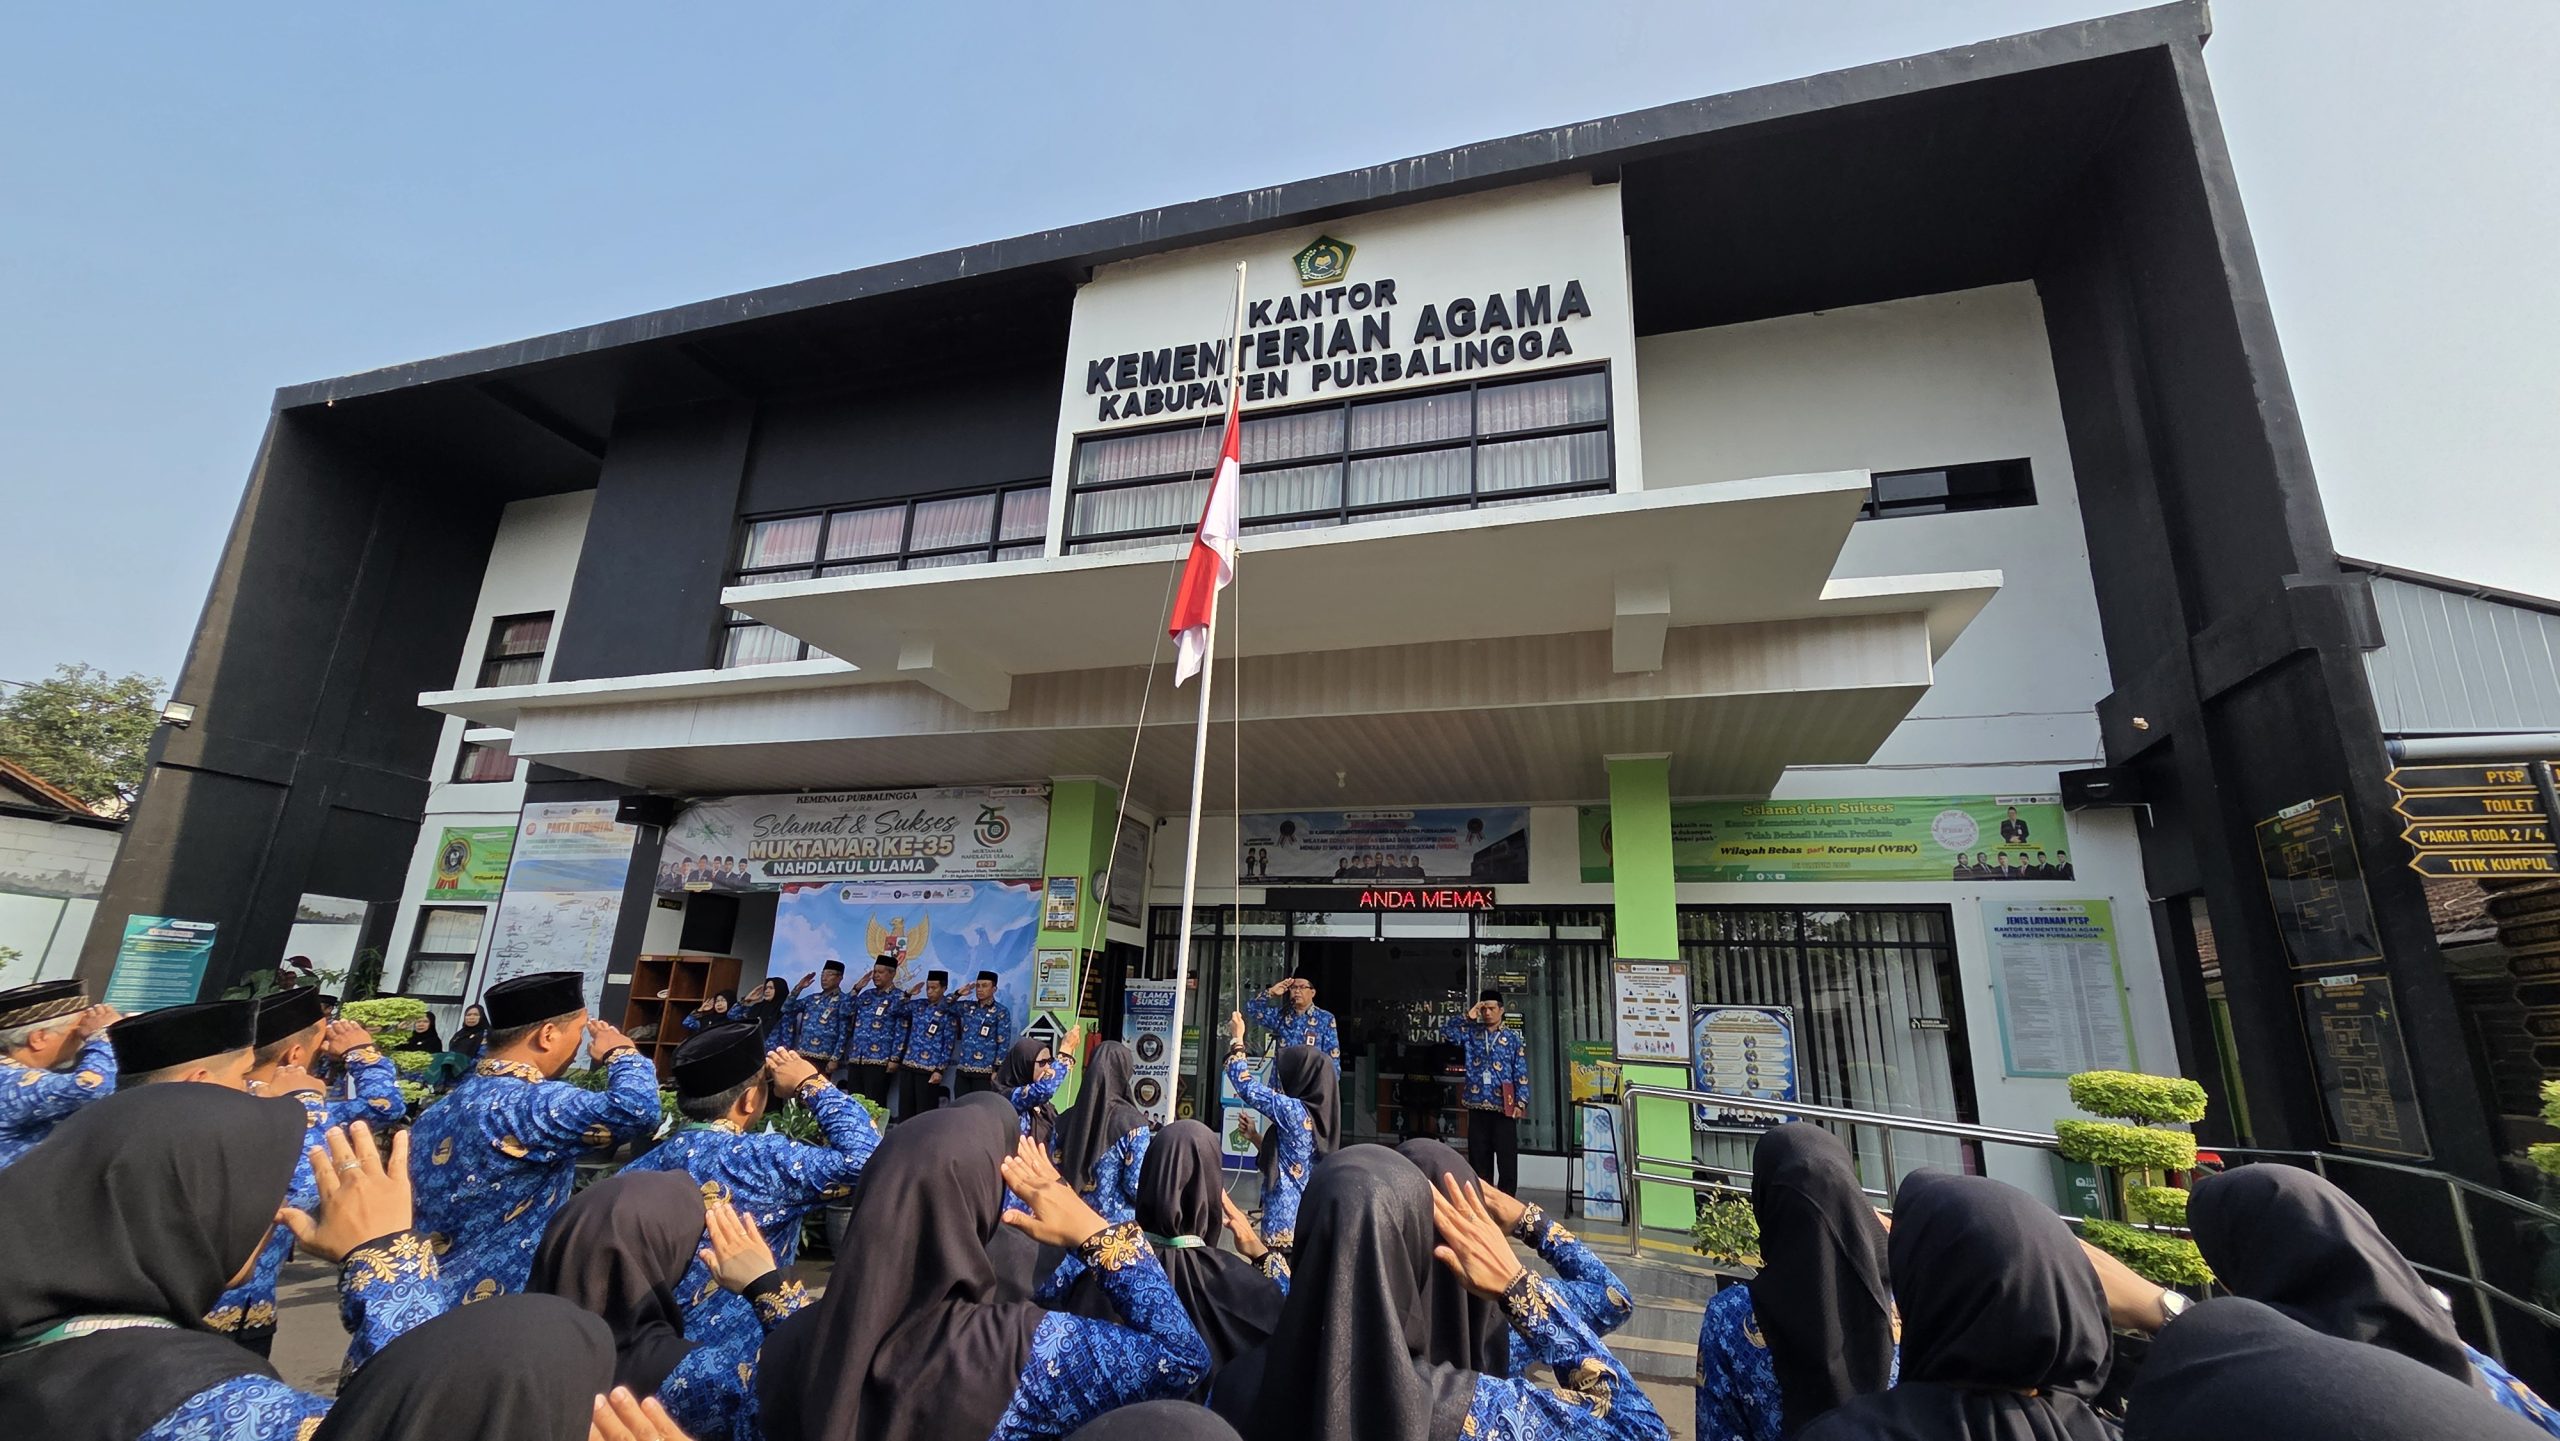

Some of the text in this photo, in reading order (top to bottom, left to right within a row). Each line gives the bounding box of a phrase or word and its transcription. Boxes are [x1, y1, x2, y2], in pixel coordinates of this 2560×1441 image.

[1249, 279, 1397, 328] KANTOR
[1086, 280, 1592, 395] KEMENTERIAN AGAMA
[1312, 326, 1572, 391] PURBALINGGA
[2486, 770, 2525, 783] PTSP
[796, 794, 845, 804] KEMENAG
[846, 791, 918, 803] PURBALINGGA
[1743, 802, 1895, 816] Selamat dan Sukses
[2482, 799, 2535, 813] TOILET
[752, 808, 959, 838] Selamat & Sukses
[2419, 828, 2546, 843] PARKIR RODA 2 / 4
[749, 835, 955, 861] MUKTAMAR KE-35
[1720, 846, 1766, 856] Wilayah
[1768, 846, 1802, 855] Bebas
[1828, 844, 1876, 855] Korupsi
[1878, 843, 1918, 855] (WBK)
[773, 858, 926, 875] NAHDLATUL ULAMA
[2448, 857, 2554, 872] TITIK KUMPUL
[1360, 891, 1416, 908] ANDA
[2006, 917, 2090, 925] JENIS LAYANAN PTSP
[1132, 991, 1175, 999] SELAMAT
[1135, 998, 1170, 1006] SUKSES
